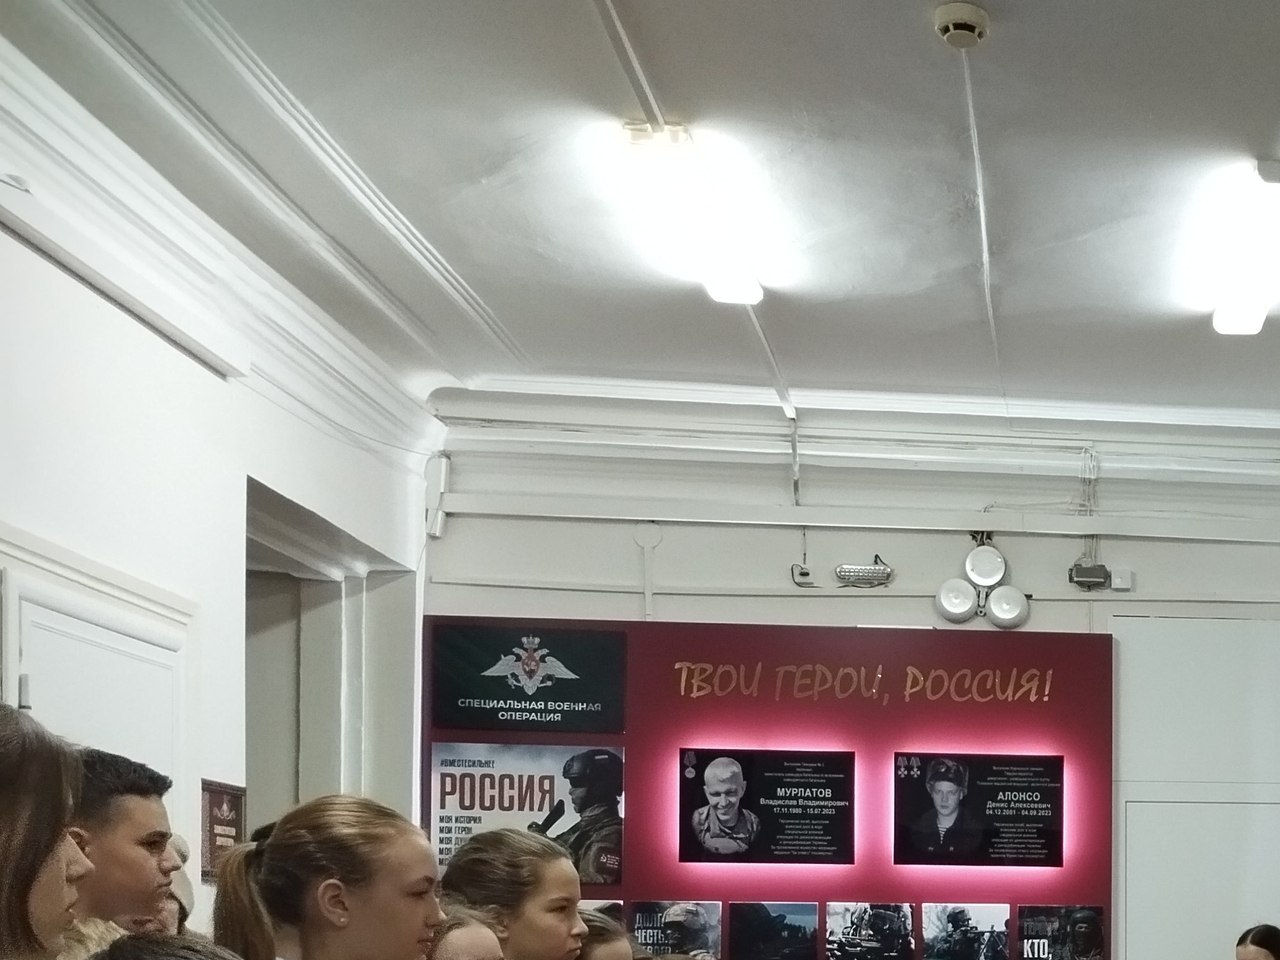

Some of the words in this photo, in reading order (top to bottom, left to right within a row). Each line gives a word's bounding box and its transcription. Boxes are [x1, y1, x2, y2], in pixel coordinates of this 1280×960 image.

[674, 662, 762, 698] ТВОИ
[775, 664, 890, 705] ГЕРОИ,
[904, 666, 1053, 702] РОССИЯ!
[458, 699, 544, 709] СПЕЦИАЛЬНАЯ
[547, 702, 601, 711] ВОЕННАЯ
[498, 712, 561, 721] ОПЕРАЦИЯ
[440, 759, 494, 768] #ВМЕСТЕСИЛЬНЕЕ
[440, 772, 555, 812] РОССИЯ
[777, 788, 832, 797] МУРЛАТОВ
[997, 792, 1040, 801] АЛОНСО
[799, 799, 848, 807] Владимирович
[455, 816, 482, 824] ИСТОРИЯ
[635, 929, 668, 943] ЧЕСТЬ.
[1023, 939, 1052, 960] КТО,
